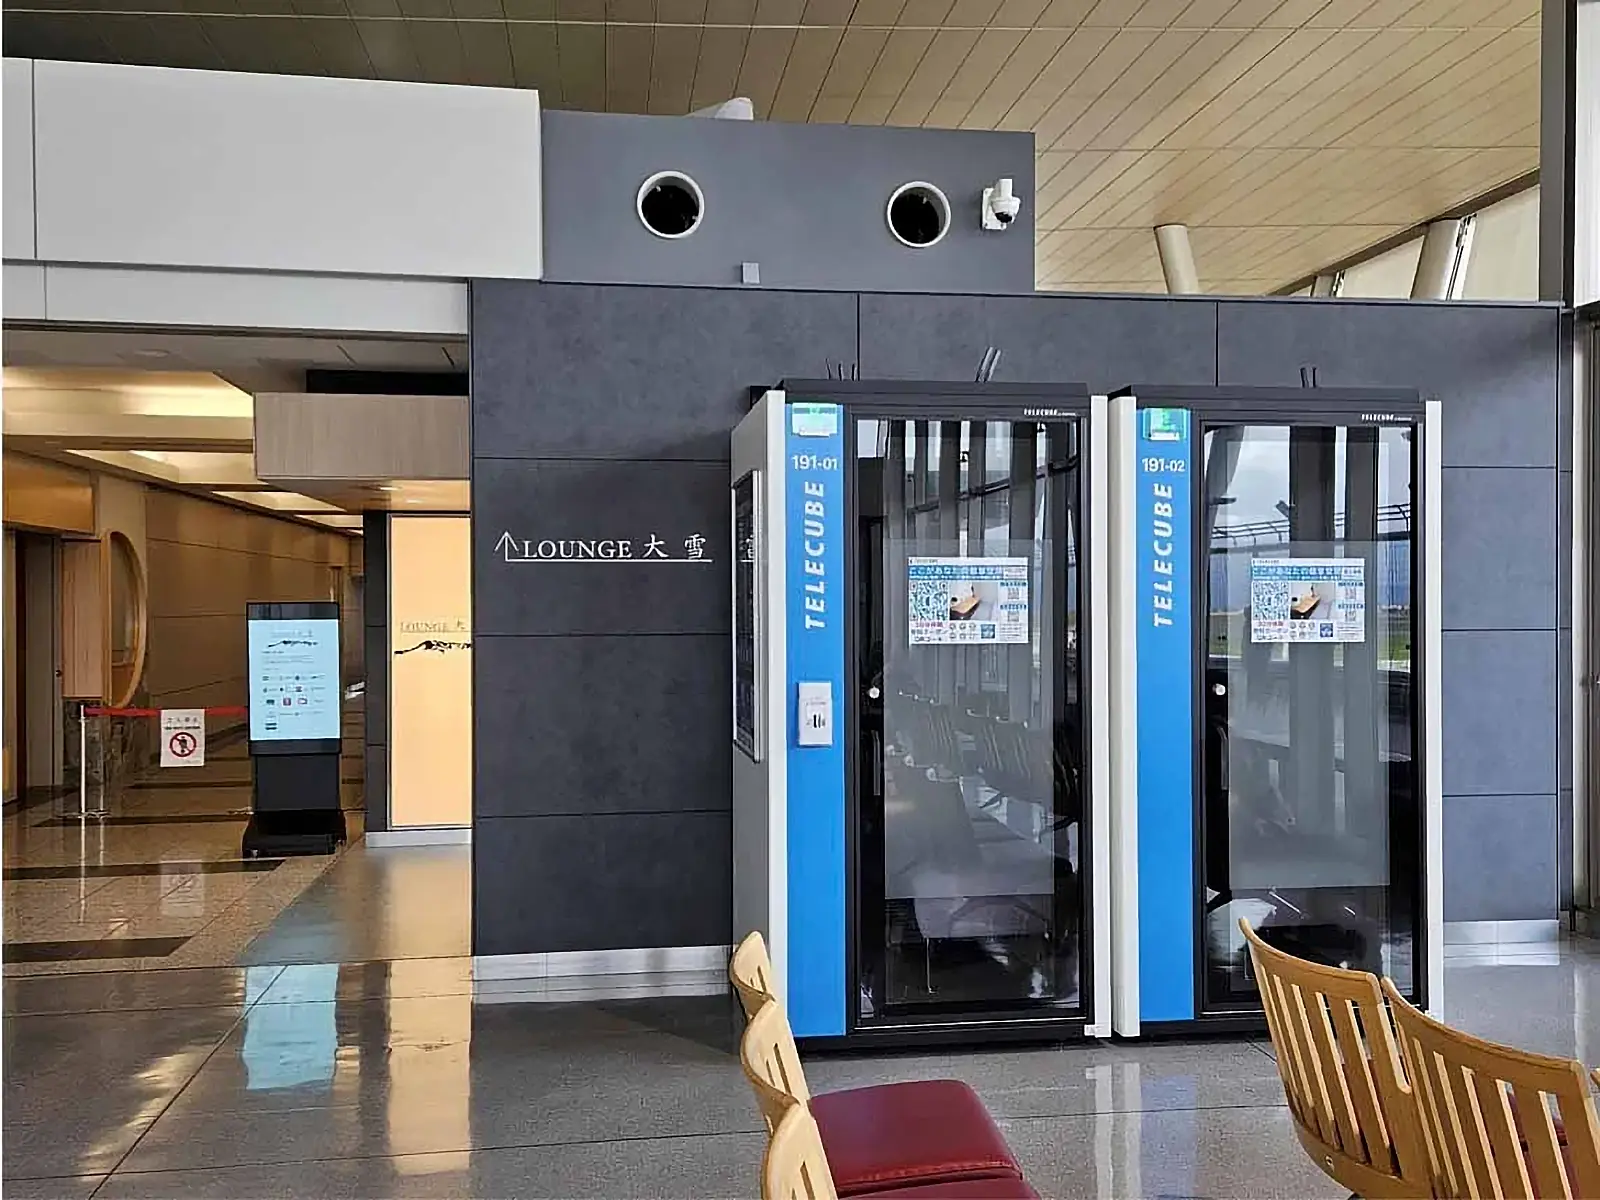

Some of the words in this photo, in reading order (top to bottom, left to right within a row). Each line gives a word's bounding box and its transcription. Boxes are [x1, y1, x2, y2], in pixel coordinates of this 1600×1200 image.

[791, 454, 838, 471] 191-01
[1141, 457, 1186, 473] 191-02
[523, 540, 632, 558] LOUNGE
[804, 481, 826, 630] TELECUBE
[1153, 483, 1174, 628] TELECUBE
